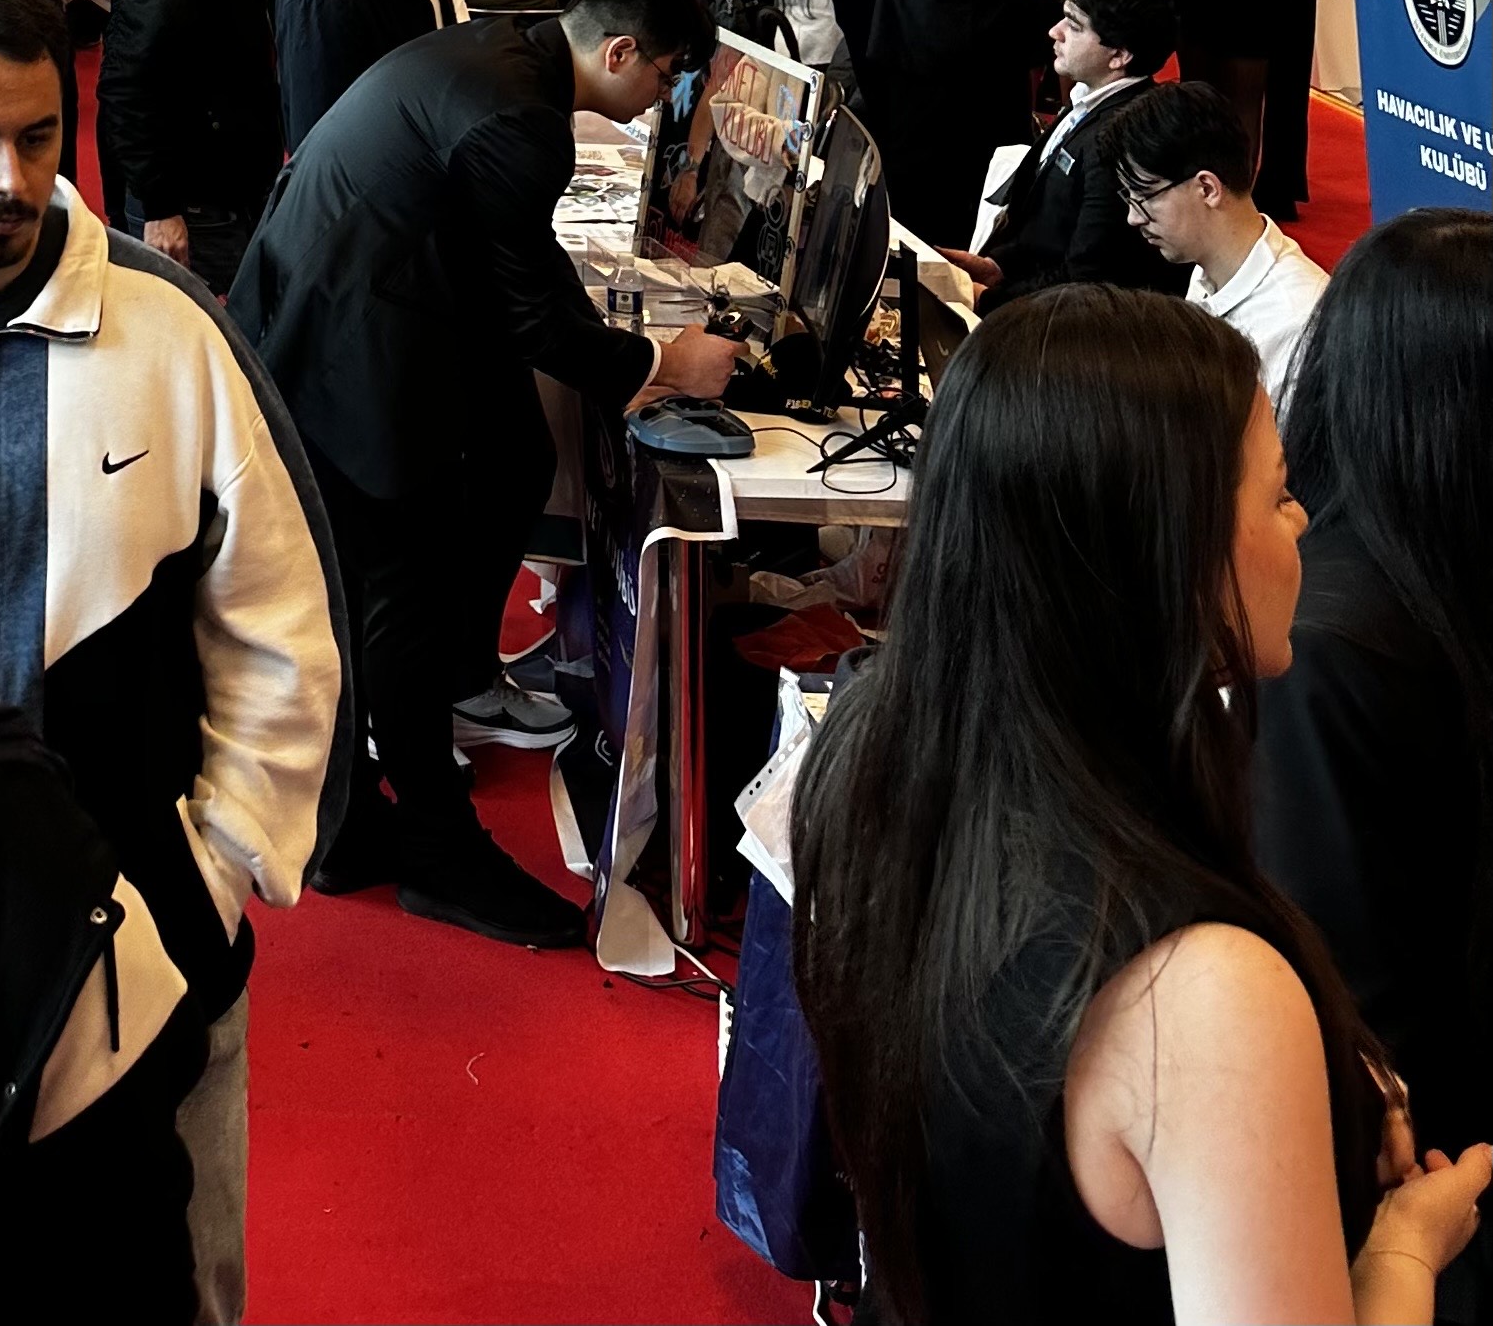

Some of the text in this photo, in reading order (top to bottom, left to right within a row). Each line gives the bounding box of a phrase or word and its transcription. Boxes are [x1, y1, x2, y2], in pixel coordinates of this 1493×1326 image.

[1377, 89, 1457, 141] HAVACILIK
[1460, 121, 1483, 152] VE
[1419, 144, 1488, 191] KULÜBÜ
